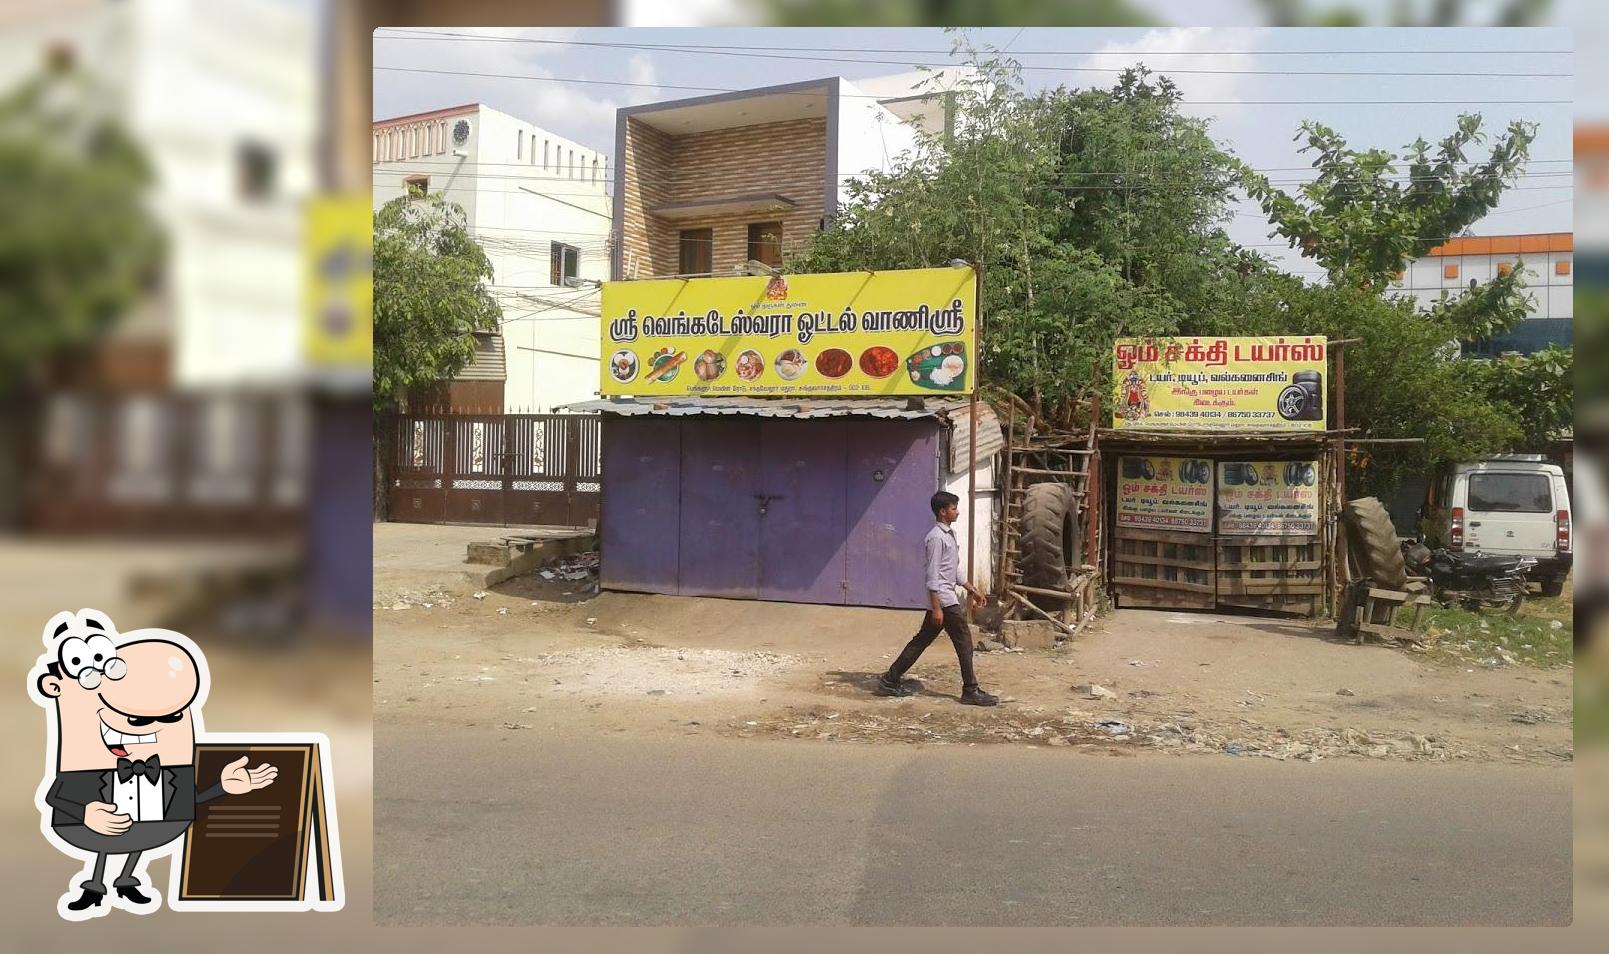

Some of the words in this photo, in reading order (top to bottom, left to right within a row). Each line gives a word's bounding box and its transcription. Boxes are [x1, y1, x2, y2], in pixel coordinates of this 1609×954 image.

[610, 309, 638, 342] ஸ்ரீ
[643, 309, 793, 339] வெங்கடேஸ்வரா
[862, 299, 964, 335] வாணிஸ்ரீ
[1117, 338, 1159, 369] ஓம்
[1164, 338, 1228, 367] சக்தி
[1234, 337, 1324, 361] டயர்ஸ்
